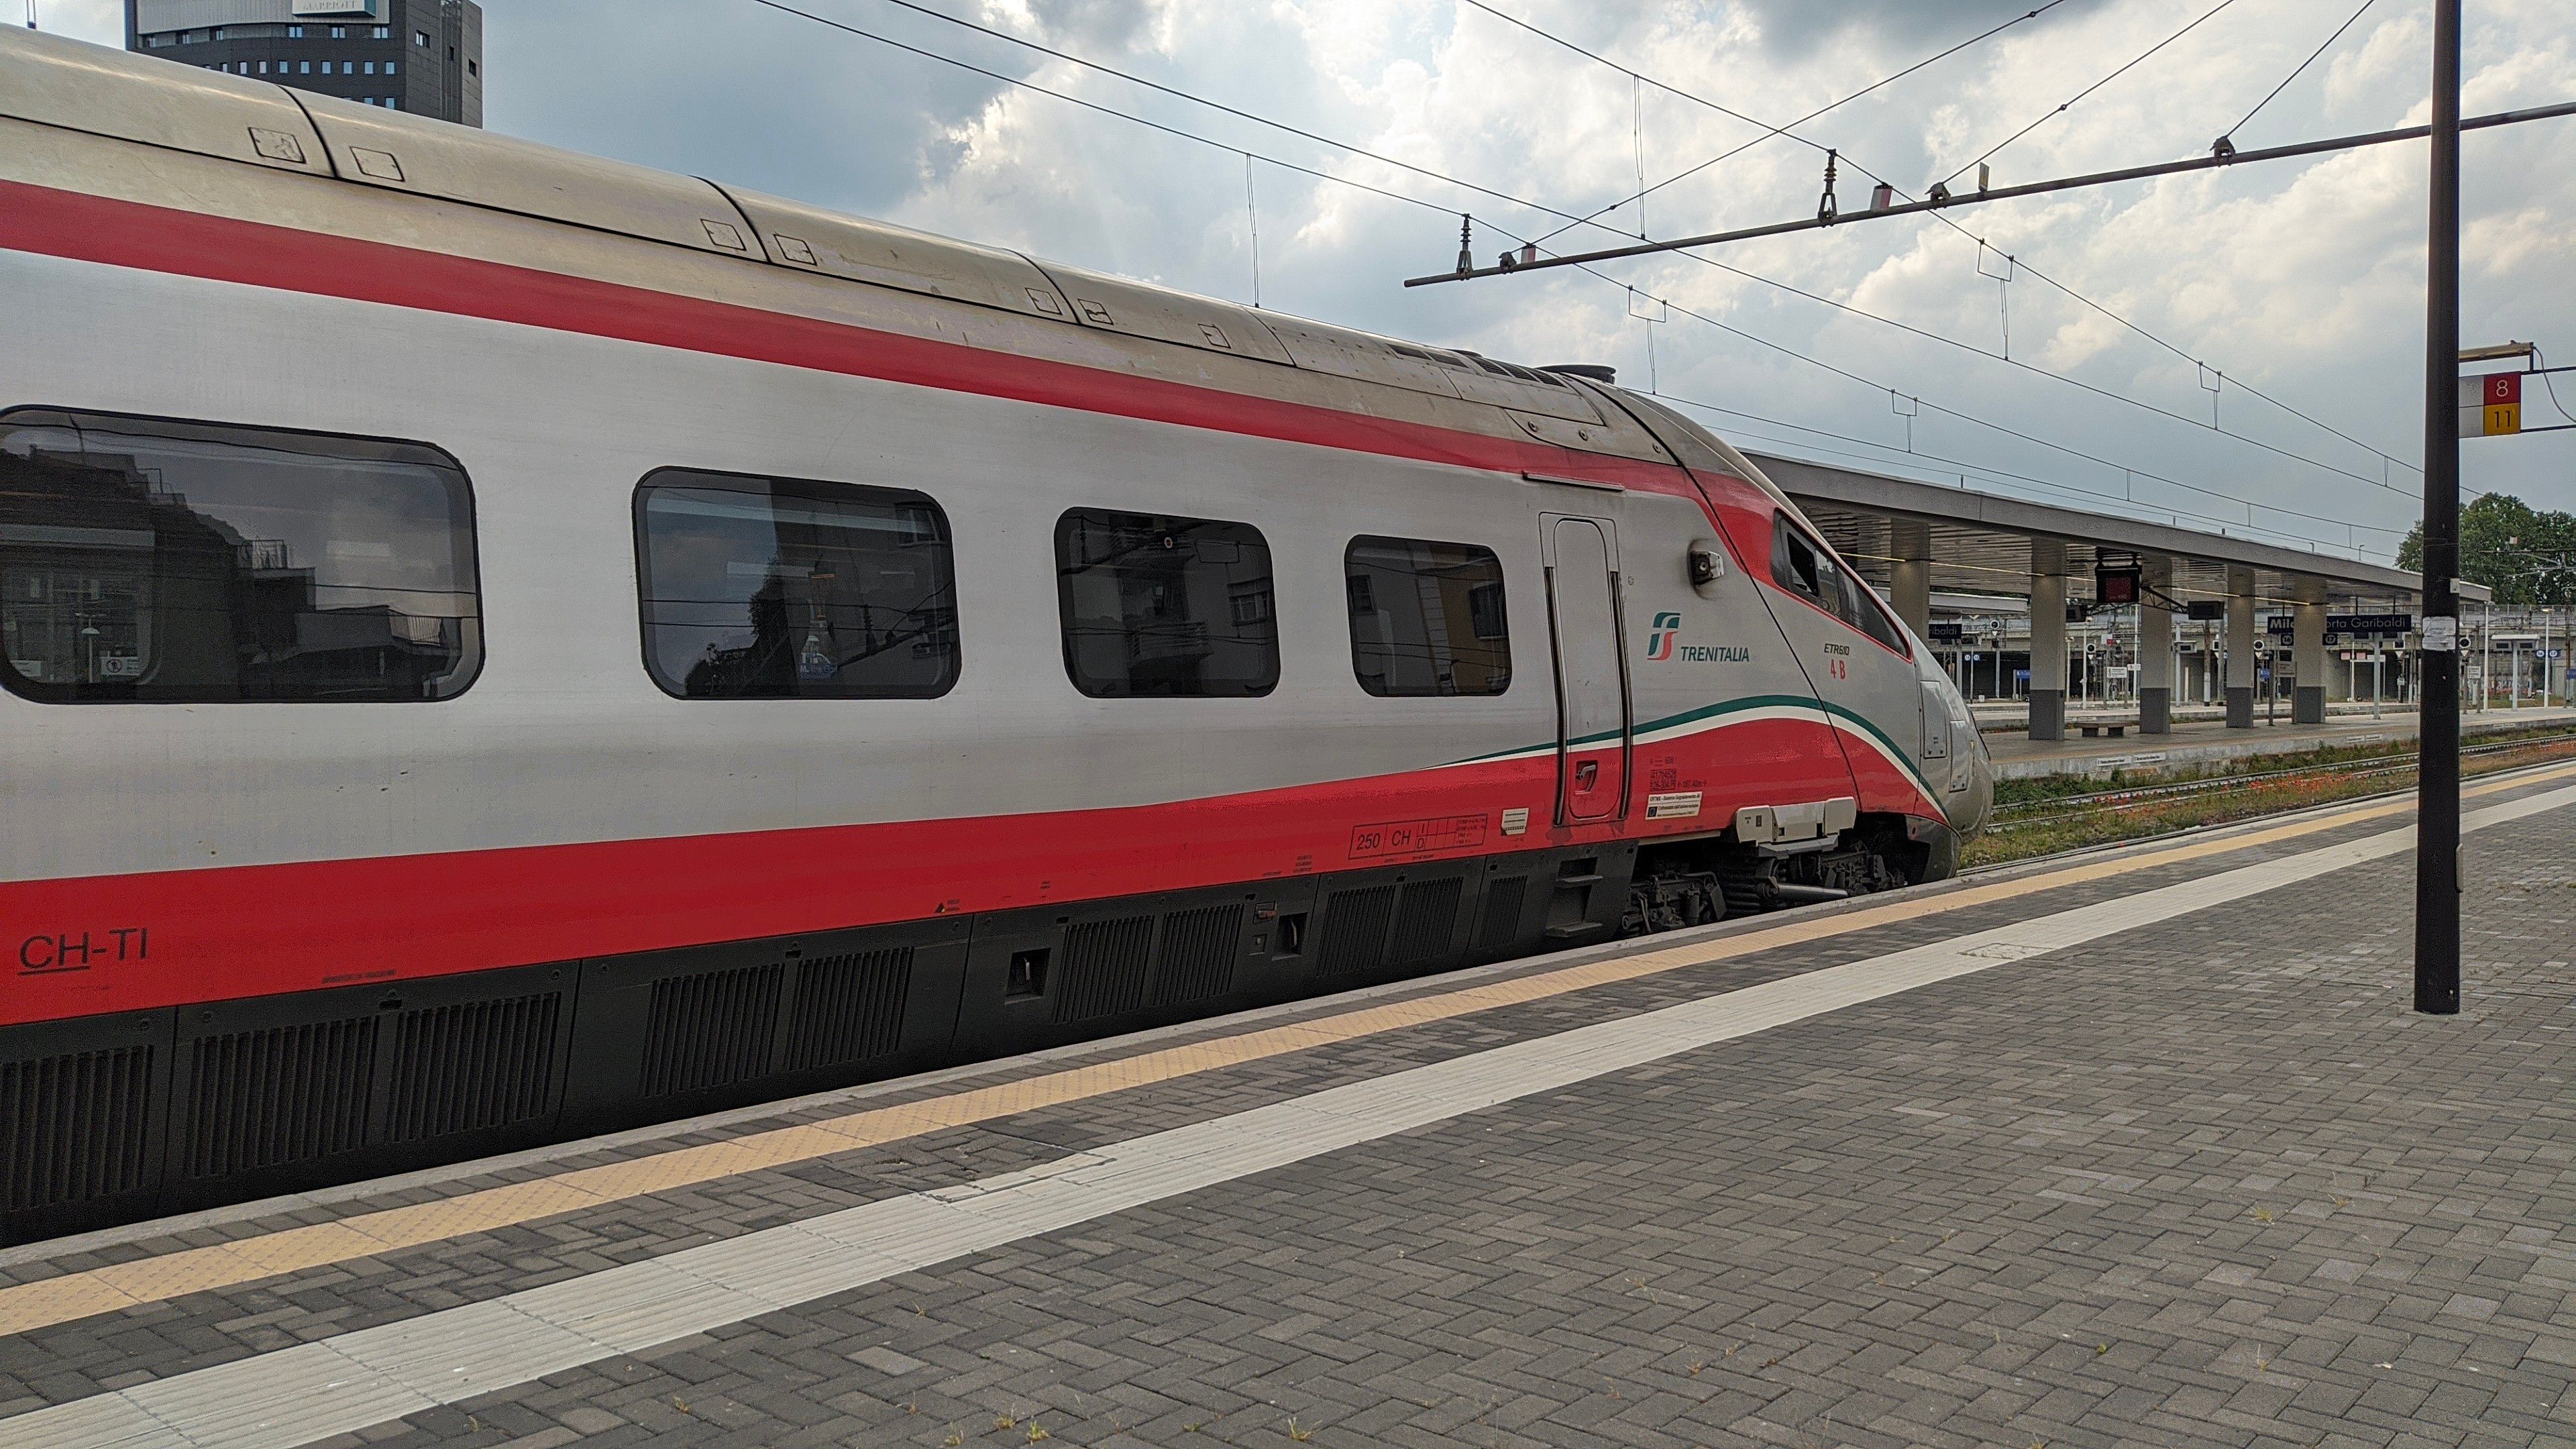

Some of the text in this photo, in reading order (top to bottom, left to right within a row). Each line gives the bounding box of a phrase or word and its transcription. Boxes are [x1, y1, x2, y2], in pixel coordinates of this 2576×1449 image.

[2496, 380, 2509, 398] 8
[2494, 410, 2511, 429] 11
[1929, 626, 1957, 635] ribaldi
[2269, 616, 2406, 629] Mil orta Garibaldi
[1680, 646, 1750, 662] TRENITALIA
[1824, 643, 1849, 655] ETR610
[1831, 659, 1836, 679] 4
[1356, 830, 1411, 851] 250 CH
[19, 927, 148, 970] CH-TI
